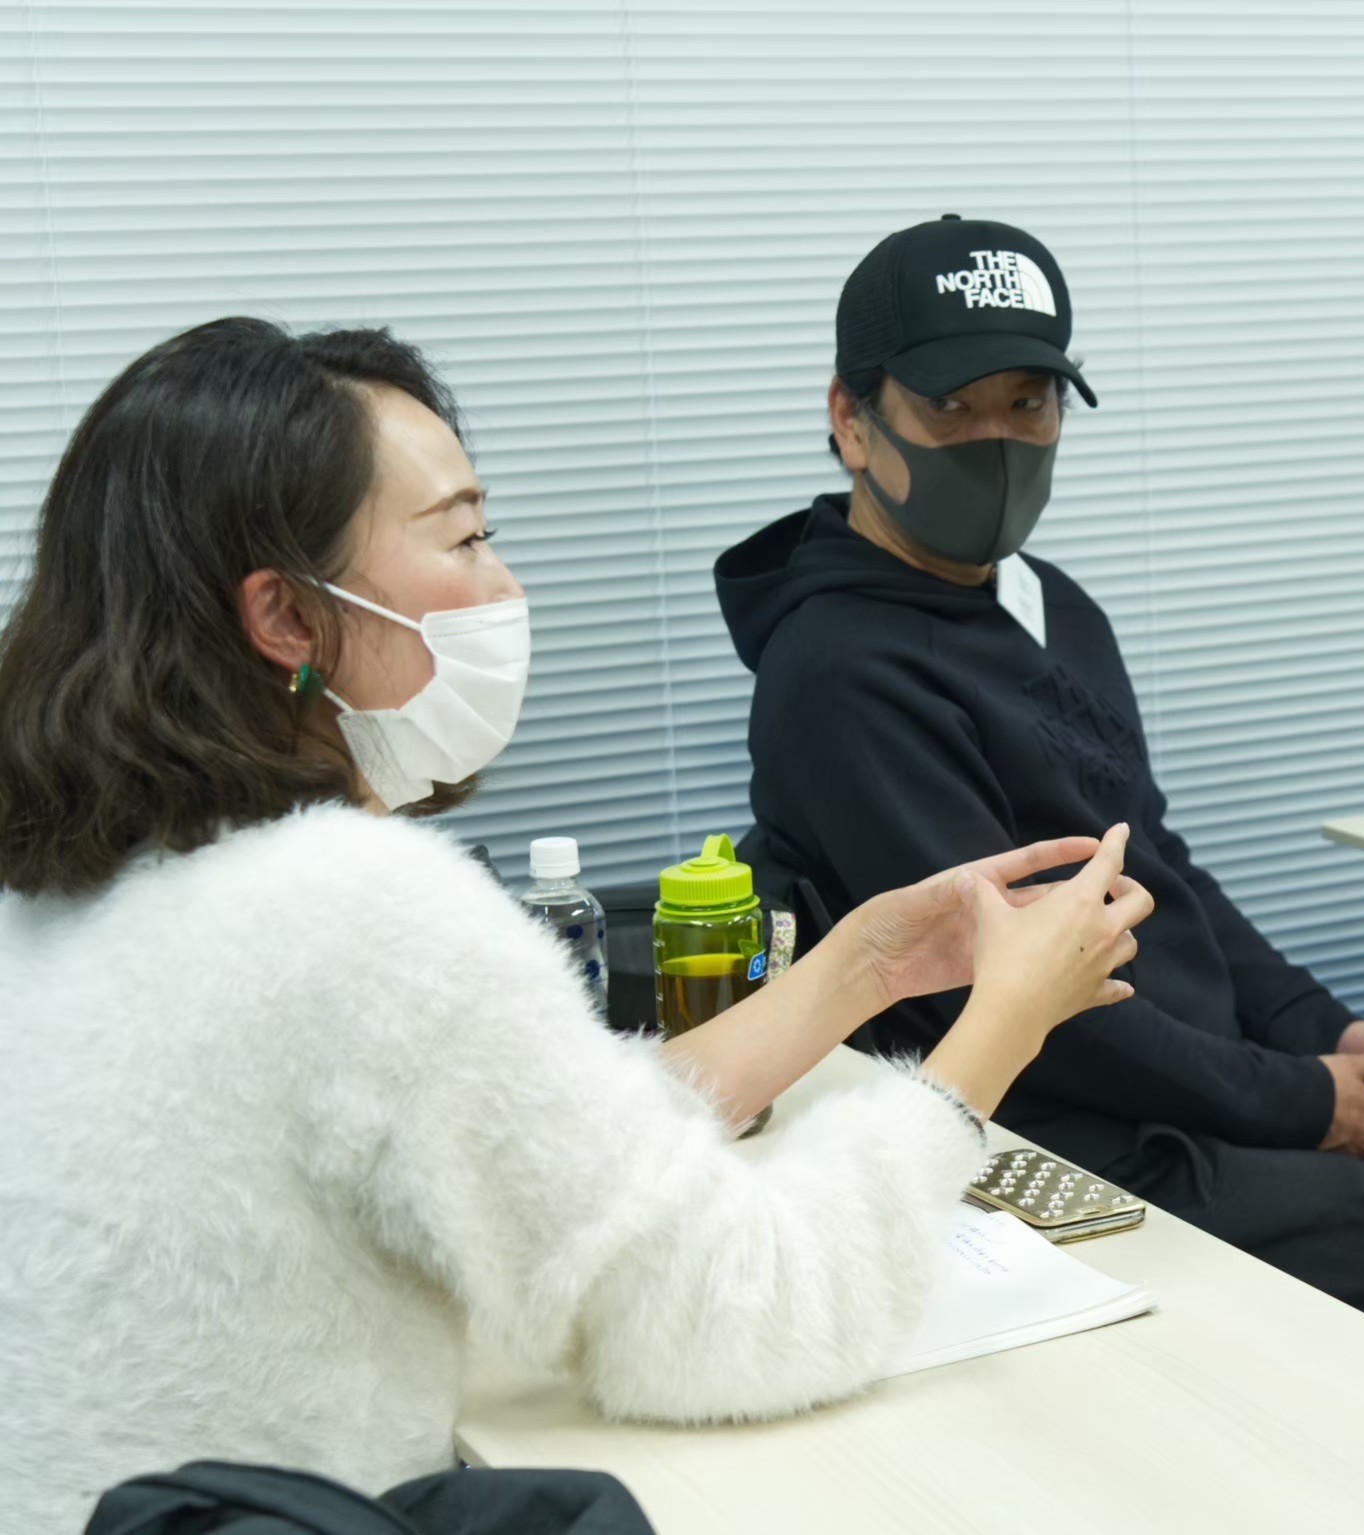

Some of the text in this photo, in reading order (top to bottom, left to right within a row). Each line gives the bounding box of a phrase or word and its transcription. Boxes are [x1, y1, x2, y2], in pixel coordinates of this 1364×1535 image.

[969, 250, 1017, 271] THE
[936, 270, 1020, 294] NORTH
[964, 288, 1025, 309] FACE
